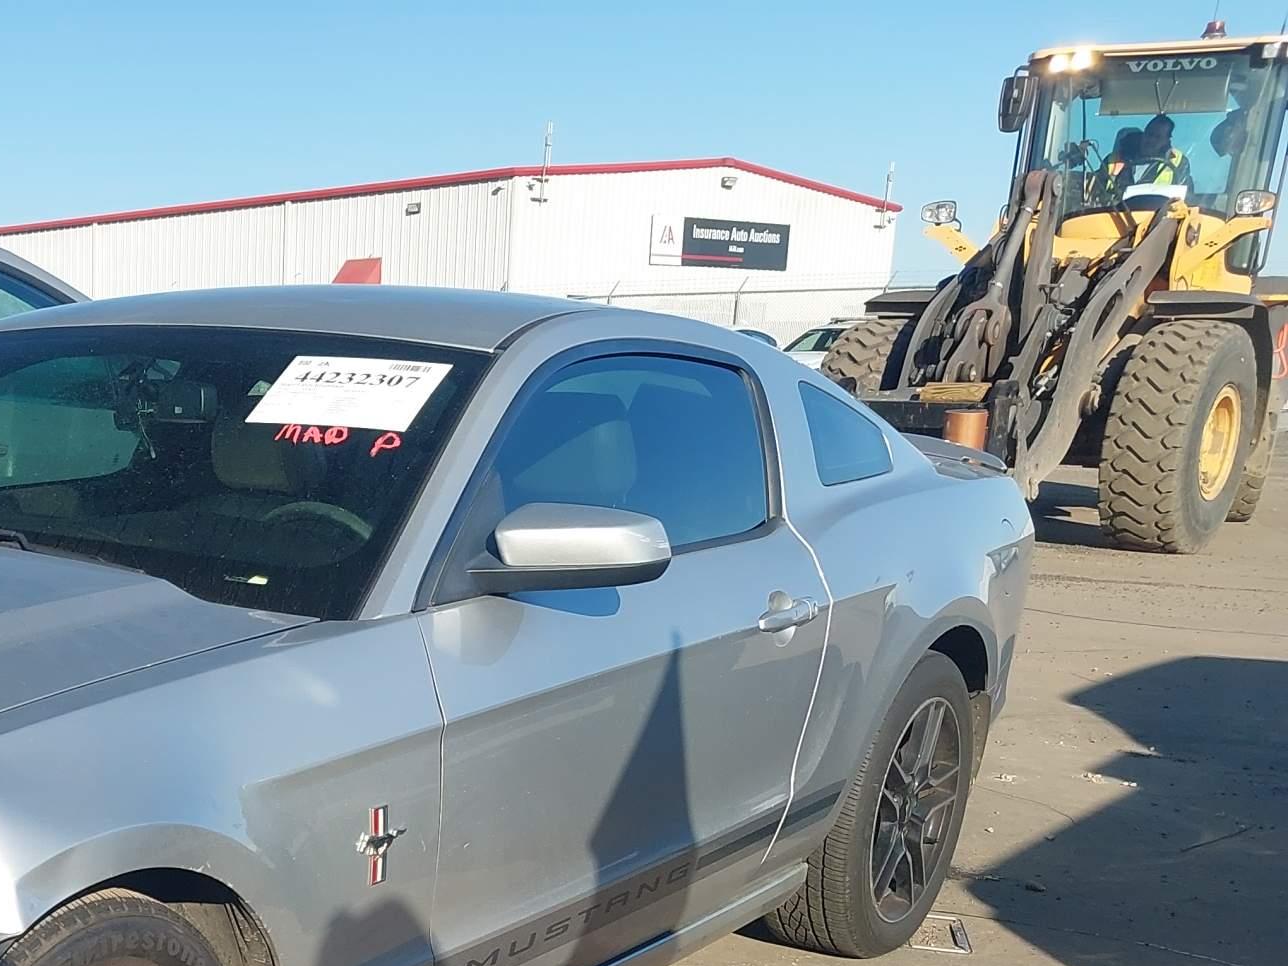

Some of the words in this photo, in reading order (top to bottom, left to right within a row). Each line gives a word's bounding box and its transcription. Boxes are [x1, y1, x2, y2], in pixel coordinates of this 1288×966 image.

[1126, 57, 1217, 73] VOLVO
[692, 223, 730, 241] Insurance
[730, 226, 748, 242] Auto
[748, 228, 781, 244] Auctions
[294, 370, 421, 389] 44232307
